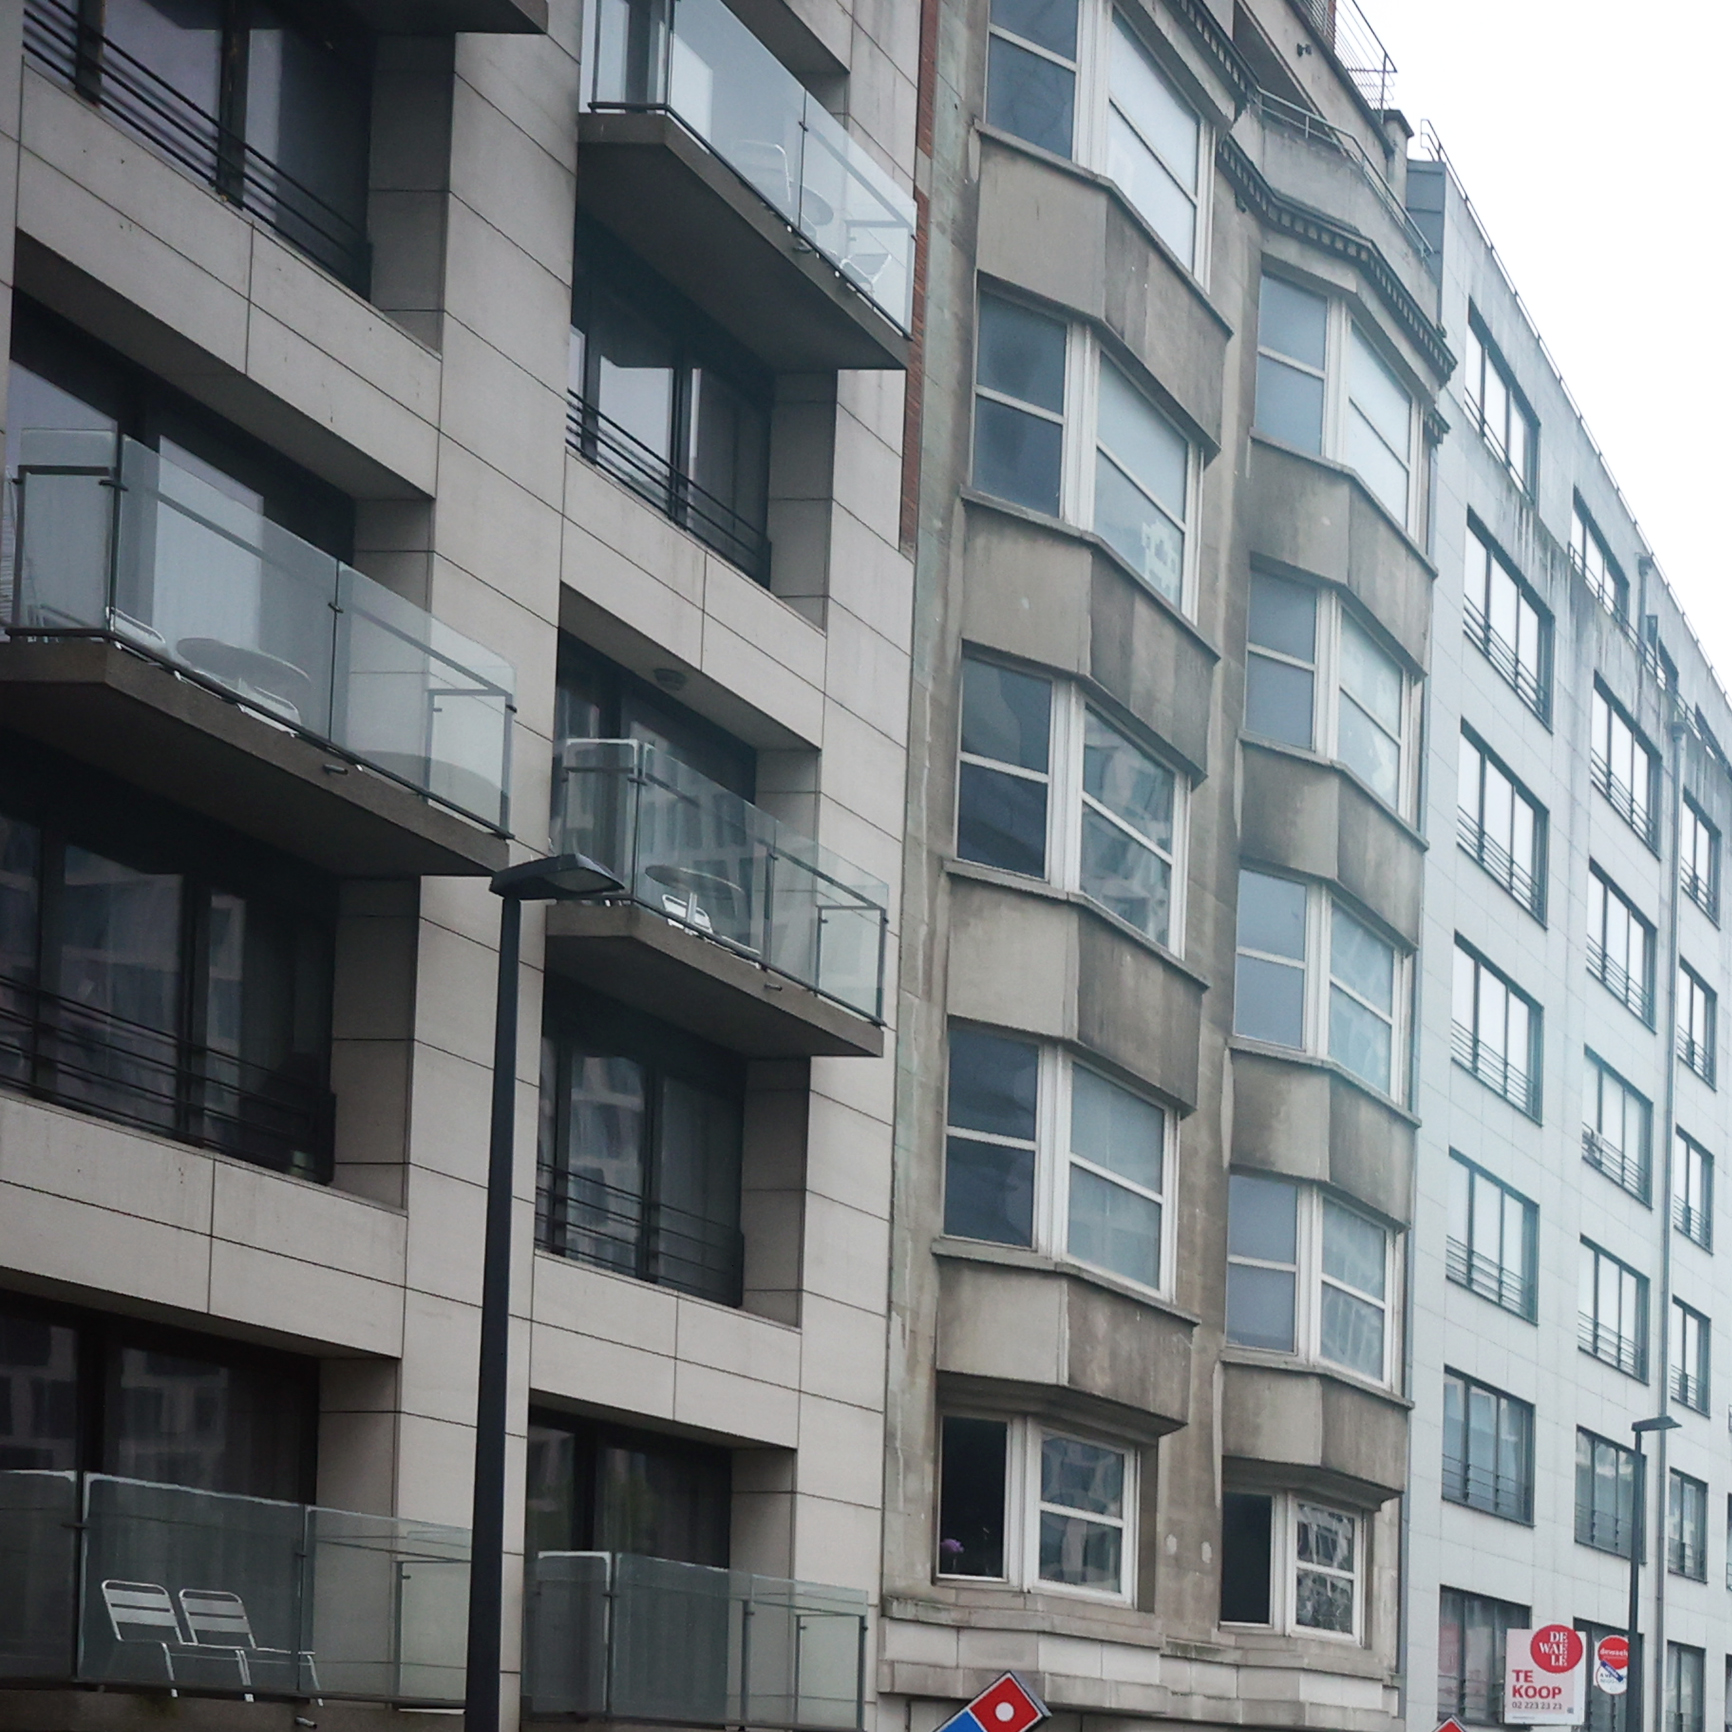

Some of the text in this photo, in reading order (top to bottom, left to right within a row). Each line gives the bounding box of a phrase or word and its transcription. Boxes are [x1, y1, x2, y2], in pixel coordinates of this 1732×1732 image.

[1550, 1631, 1568, 1643] DE
[1539, 1642, 1568, 1655] WAE
[1551, 1654, 1568, 1666] LE
[1512, 1669, 1534, 1683] TE
[1512, 1685, 1562, 1699] KOOP
